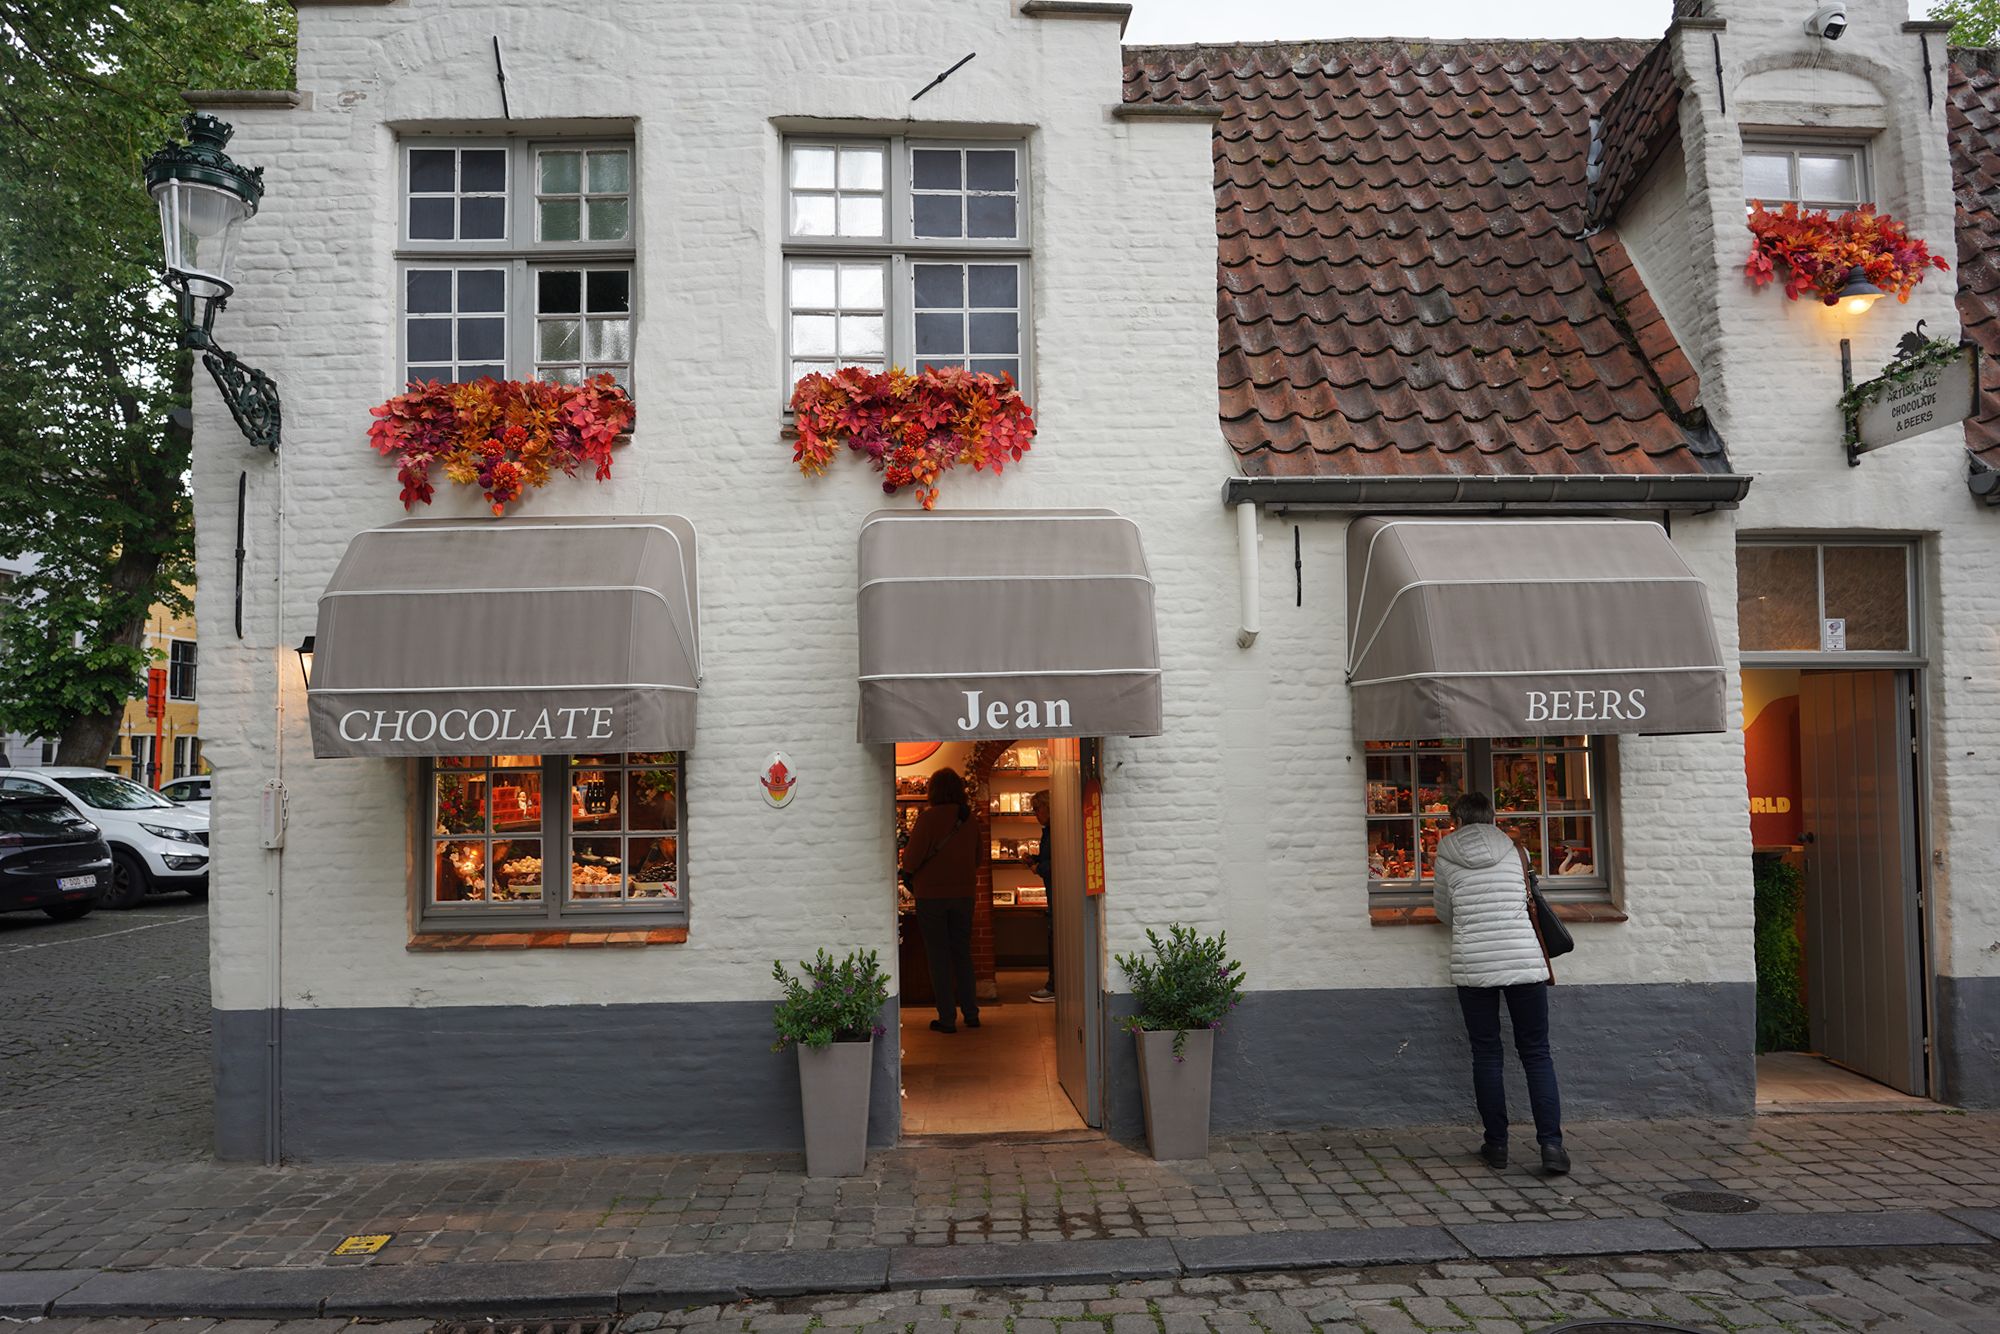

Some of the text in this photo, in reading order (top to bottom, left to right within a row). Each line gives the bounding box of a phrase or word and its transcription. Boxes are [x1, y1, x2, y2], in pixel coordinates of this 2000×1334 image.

[1896, 410, 1934, 431] & BEERS
[957, 690, 1073, 731] Jean
[1524, 688, 1647, 721] BEERS
[338, 707, 615, 742] CHOCOLATE
[1750, 796, 1791, 814] RLD
[1085, 816, 1096, 889] PROMO
